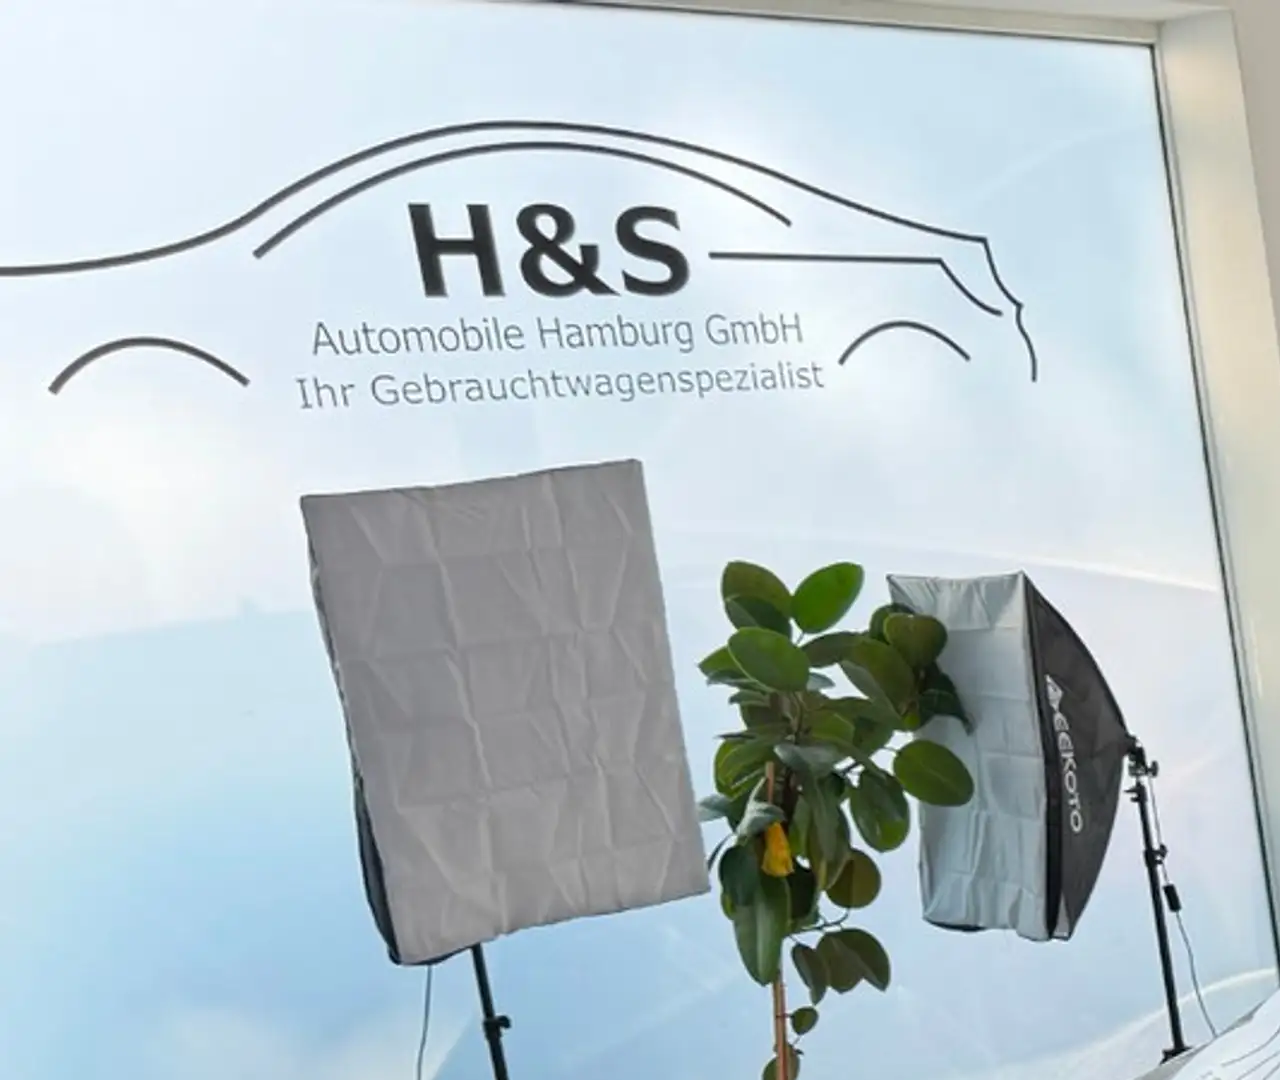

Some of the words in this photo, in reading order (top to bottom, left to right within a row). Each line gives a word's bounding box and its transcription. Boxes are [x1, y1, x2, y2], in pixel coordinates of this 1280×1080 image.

[407, 202, 690, 298] H&S
[312, 316, 525, 356] Automobile
[536, 315, 694, 353] Hamburg
[705, 312, 803, 346] GmbH
[296, 376, 355, 409] Ihr
[370, 360, 824, 406] Gebrauchtwagenspezialist
